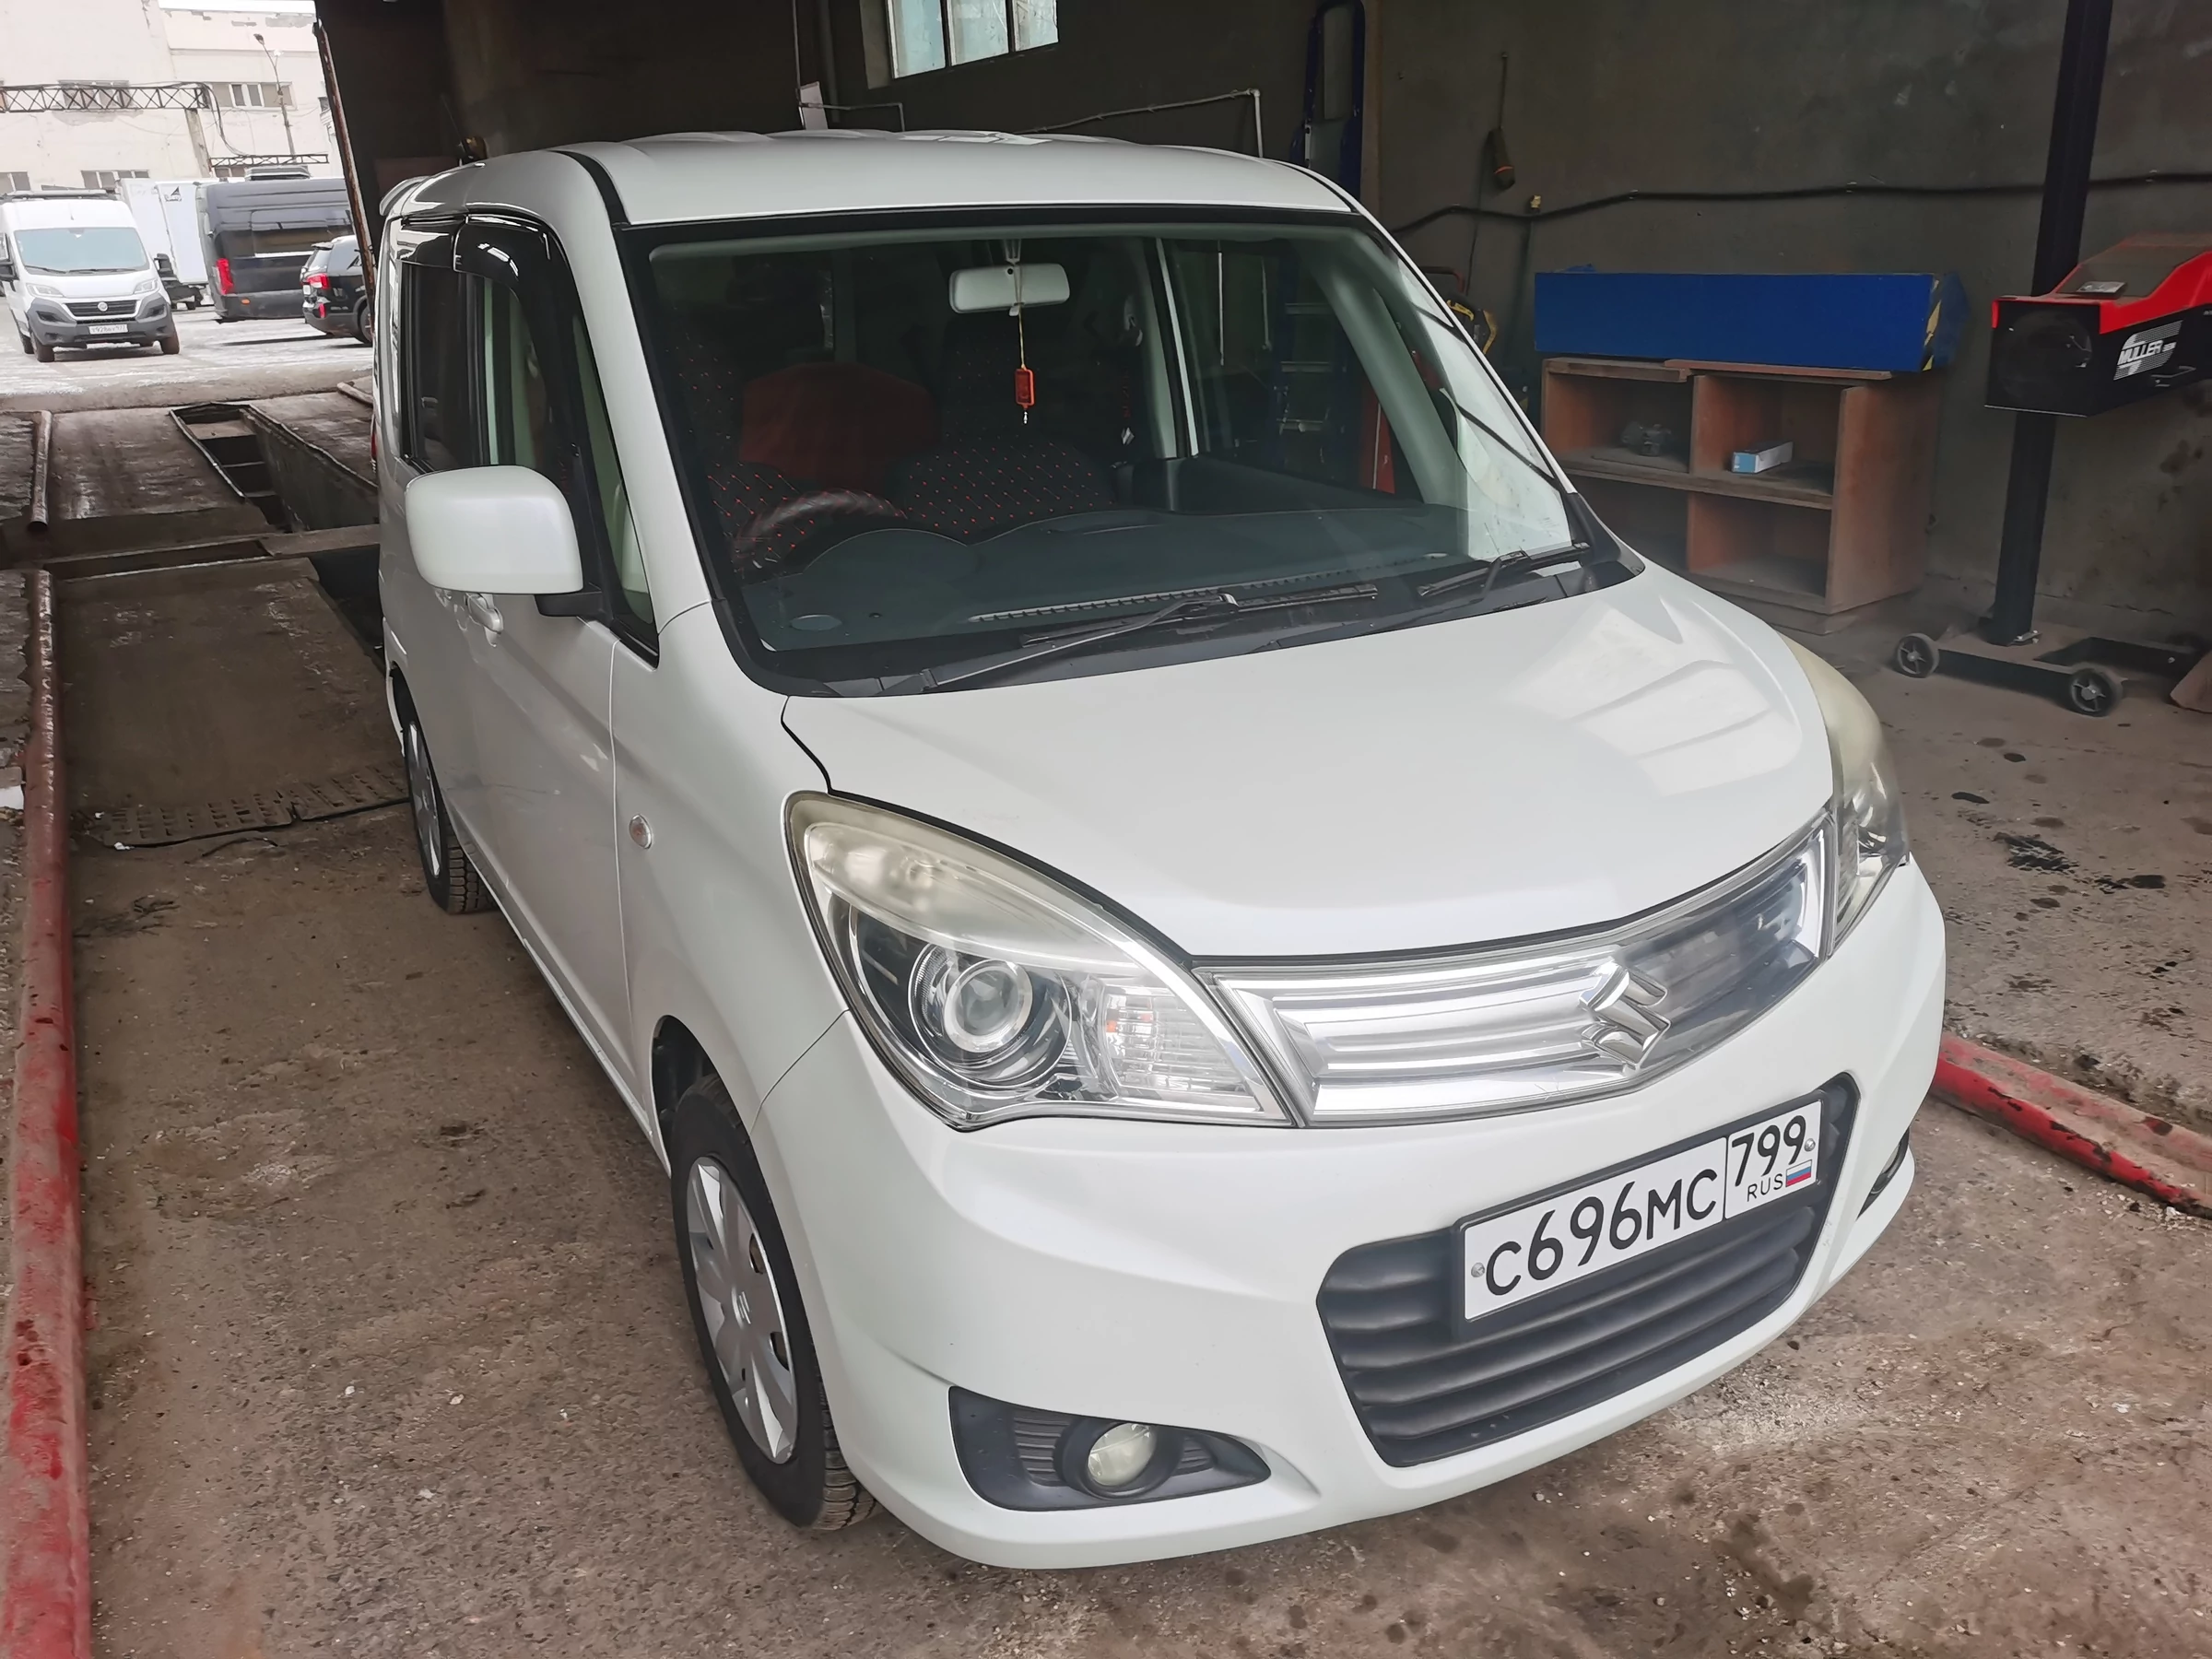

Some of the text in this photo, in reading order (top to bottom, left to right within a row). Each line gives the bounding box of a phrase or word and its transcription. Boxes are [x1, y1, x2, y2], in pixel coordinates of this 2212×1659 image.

[1486, 1115, 1807, 1296] С696МС 799
[1747, 1173, 1784, 1202] RUS
